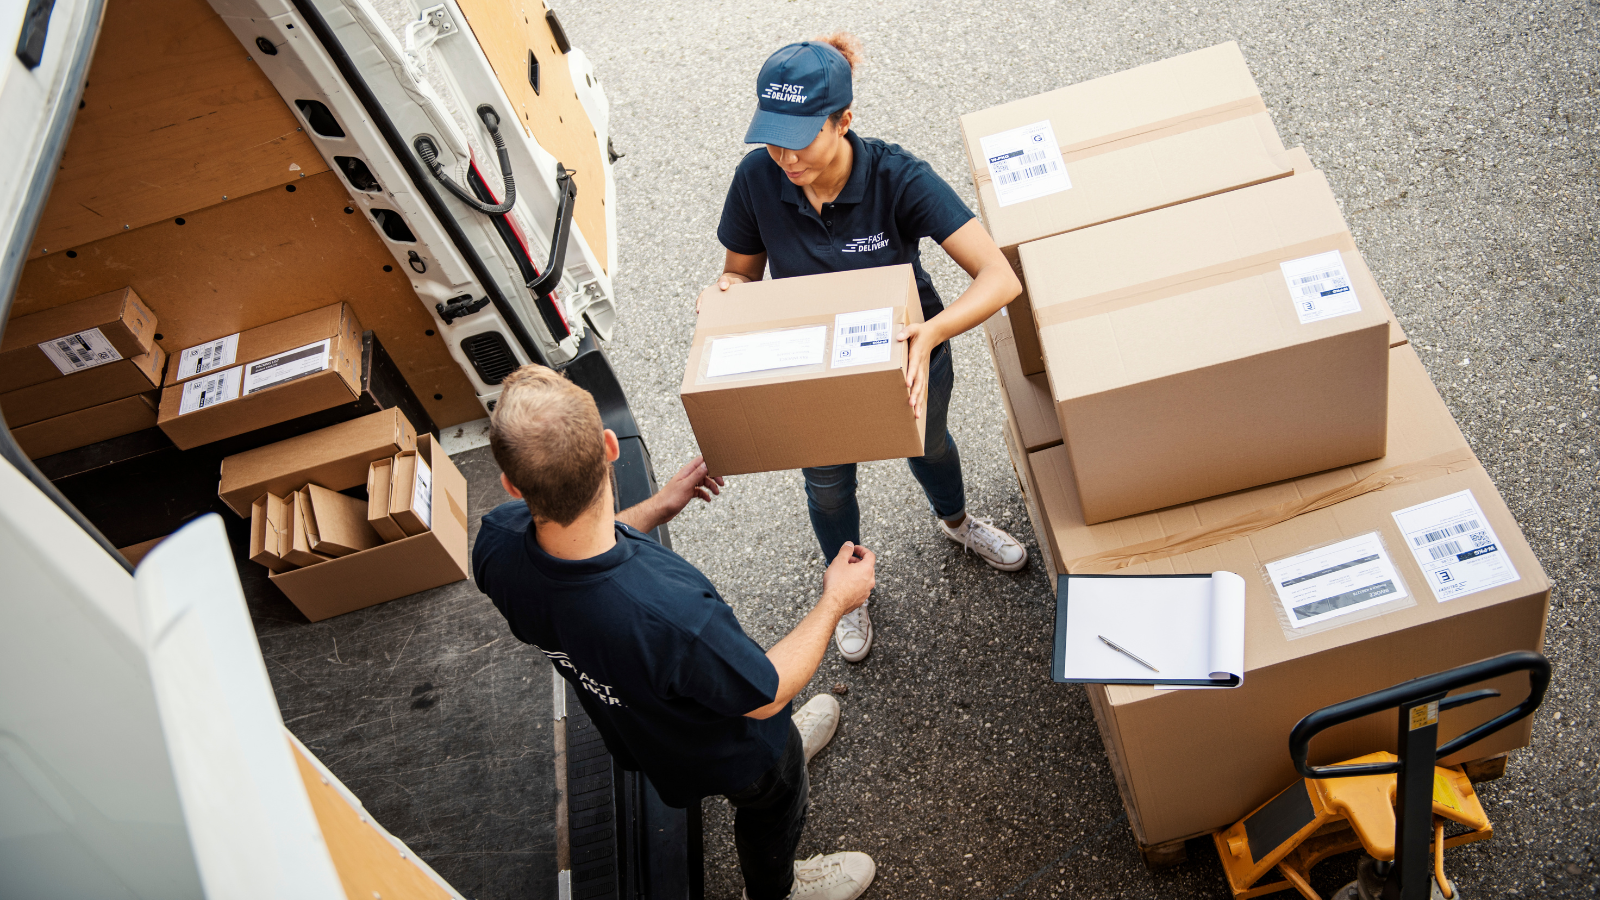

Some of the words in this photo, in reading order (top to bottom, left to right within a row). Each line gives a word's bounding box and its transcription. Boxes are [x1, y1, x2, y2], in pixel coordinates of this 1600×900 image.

[781, 83, 804, 95] FAST
[771, 91, 808, 104] DELIVERY
[868, 231, 885, 244] FAST
[858, 238, 890, 253] DELIVERY
[1439, 571, 1451, 581] E
